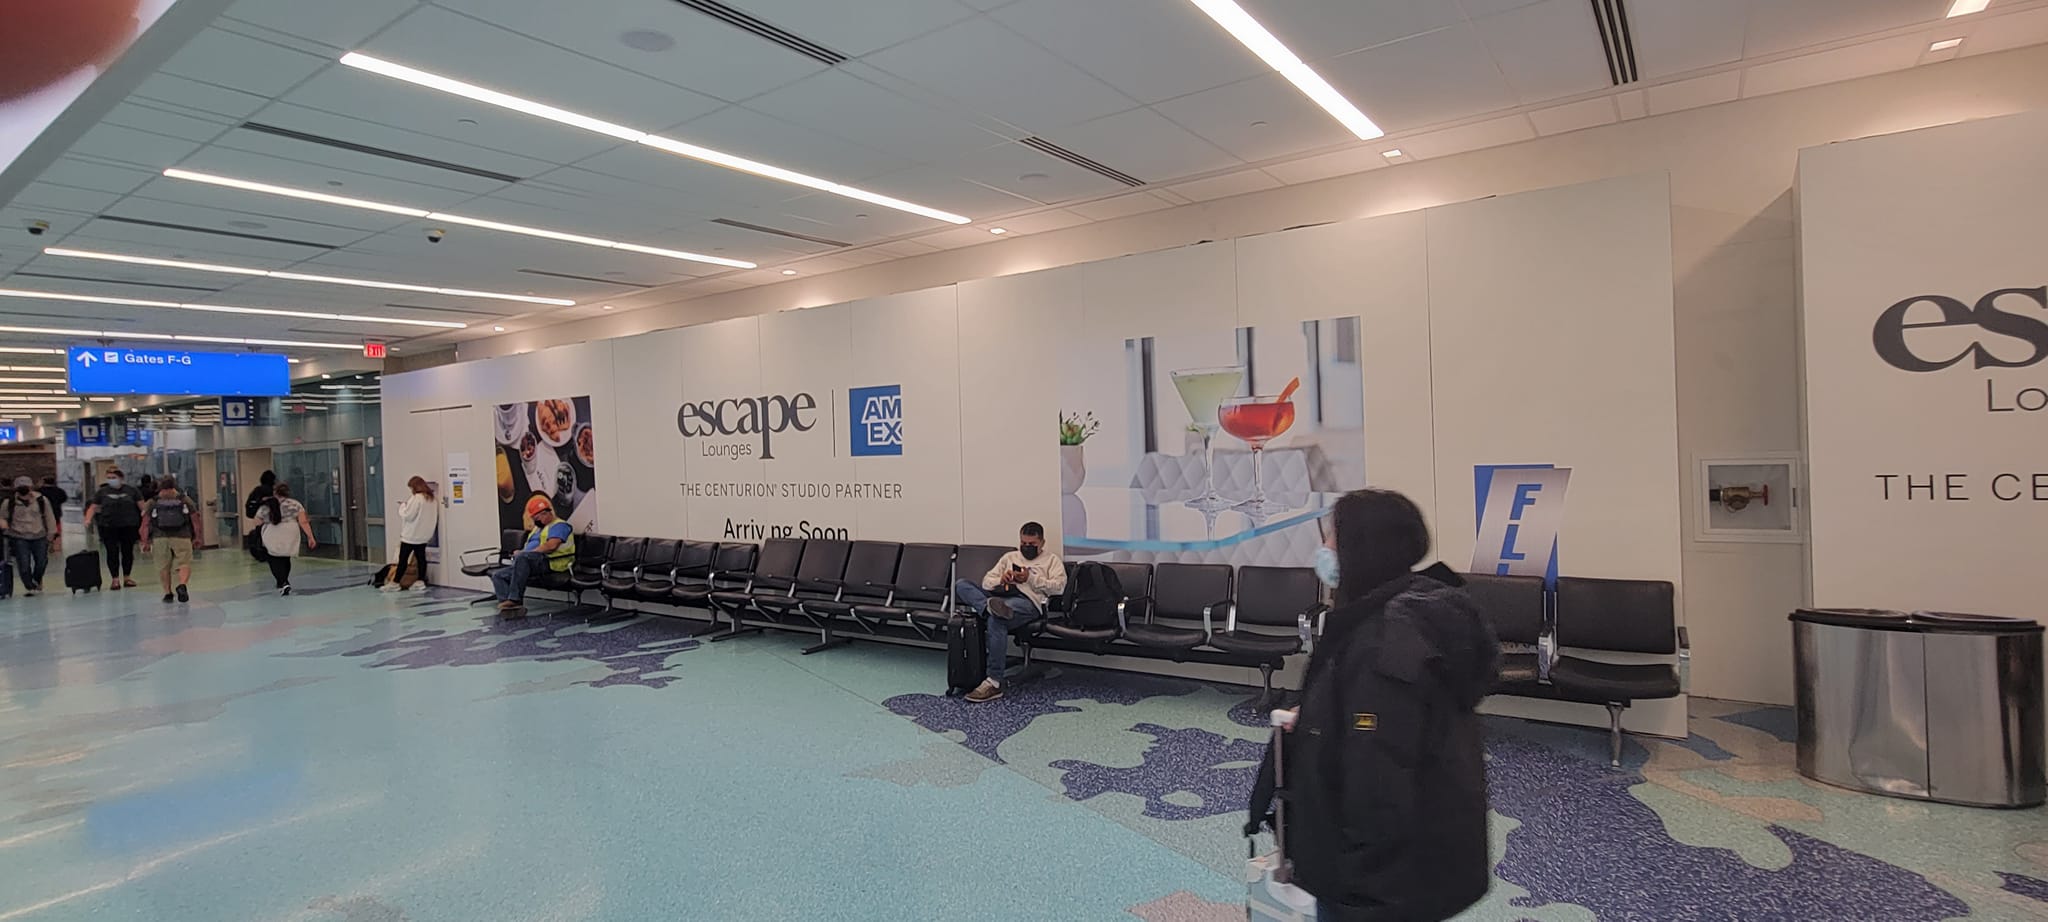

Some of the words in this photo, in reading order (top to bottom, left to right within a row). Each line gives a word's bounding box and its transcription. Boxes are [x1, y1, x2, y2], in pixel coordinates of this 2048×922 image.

[1872, 285, 2048, 372] es
[124, 353, 164, 364] Gates
[167, 355, 191, 365] F-G
[1987, 378, 2048, 412] Lo
[677, 392, 817, 460] escape
[702, 441, 752, 460] Lounges
[680, 483, 701, 497] THE
[781, 482, 831, 498] STUDIO
[835, 483, 903, 499] PARTNER
[1874, 473, 1970, 500] THE
[1991, 473, 2048, 501] CE
